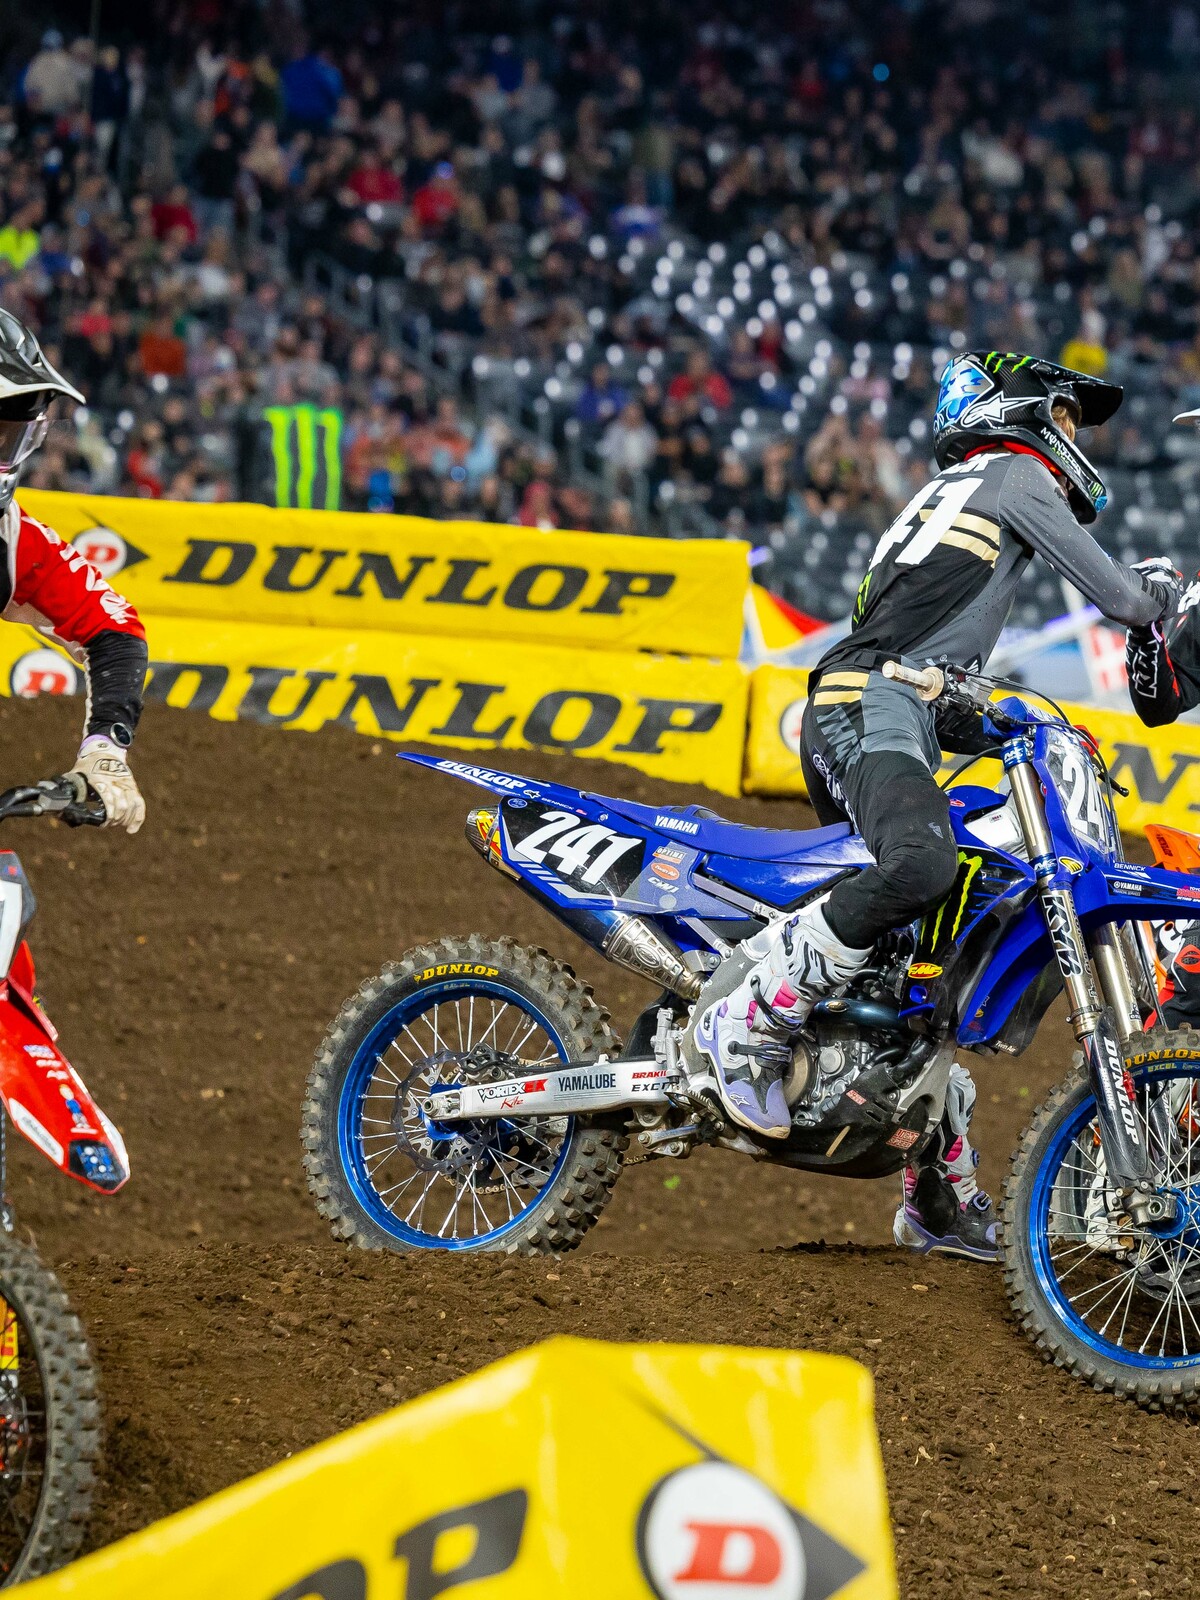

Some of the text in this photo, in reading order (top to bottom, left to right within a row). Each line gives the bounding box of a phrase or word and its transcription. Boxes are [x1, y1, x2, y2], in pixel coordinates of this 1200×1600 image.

[162, 537, 678, 615] DUNLOP
[436, 760, 527, 789] DUNLOP
[654, 815, 700, 835] YAMAHA
[515, 811, 643, 886] 241
[1113, 862, 1146, 872] BENNICK
[1120, 882, 1142, 892] YAMAHA
[422, 963, 499, 981] DUNLOP
[907, 964, 943, 979] FMF
[1147, 1062, 1178, 1073] EXCEL
[477, 1081, 526, 1103] VORTEX
[558, 1073, 617, 1092] YAMALUBE
[1103, 1036, 1140, 1145] DUNLOP
[673, 1522, 784, 1585] D
